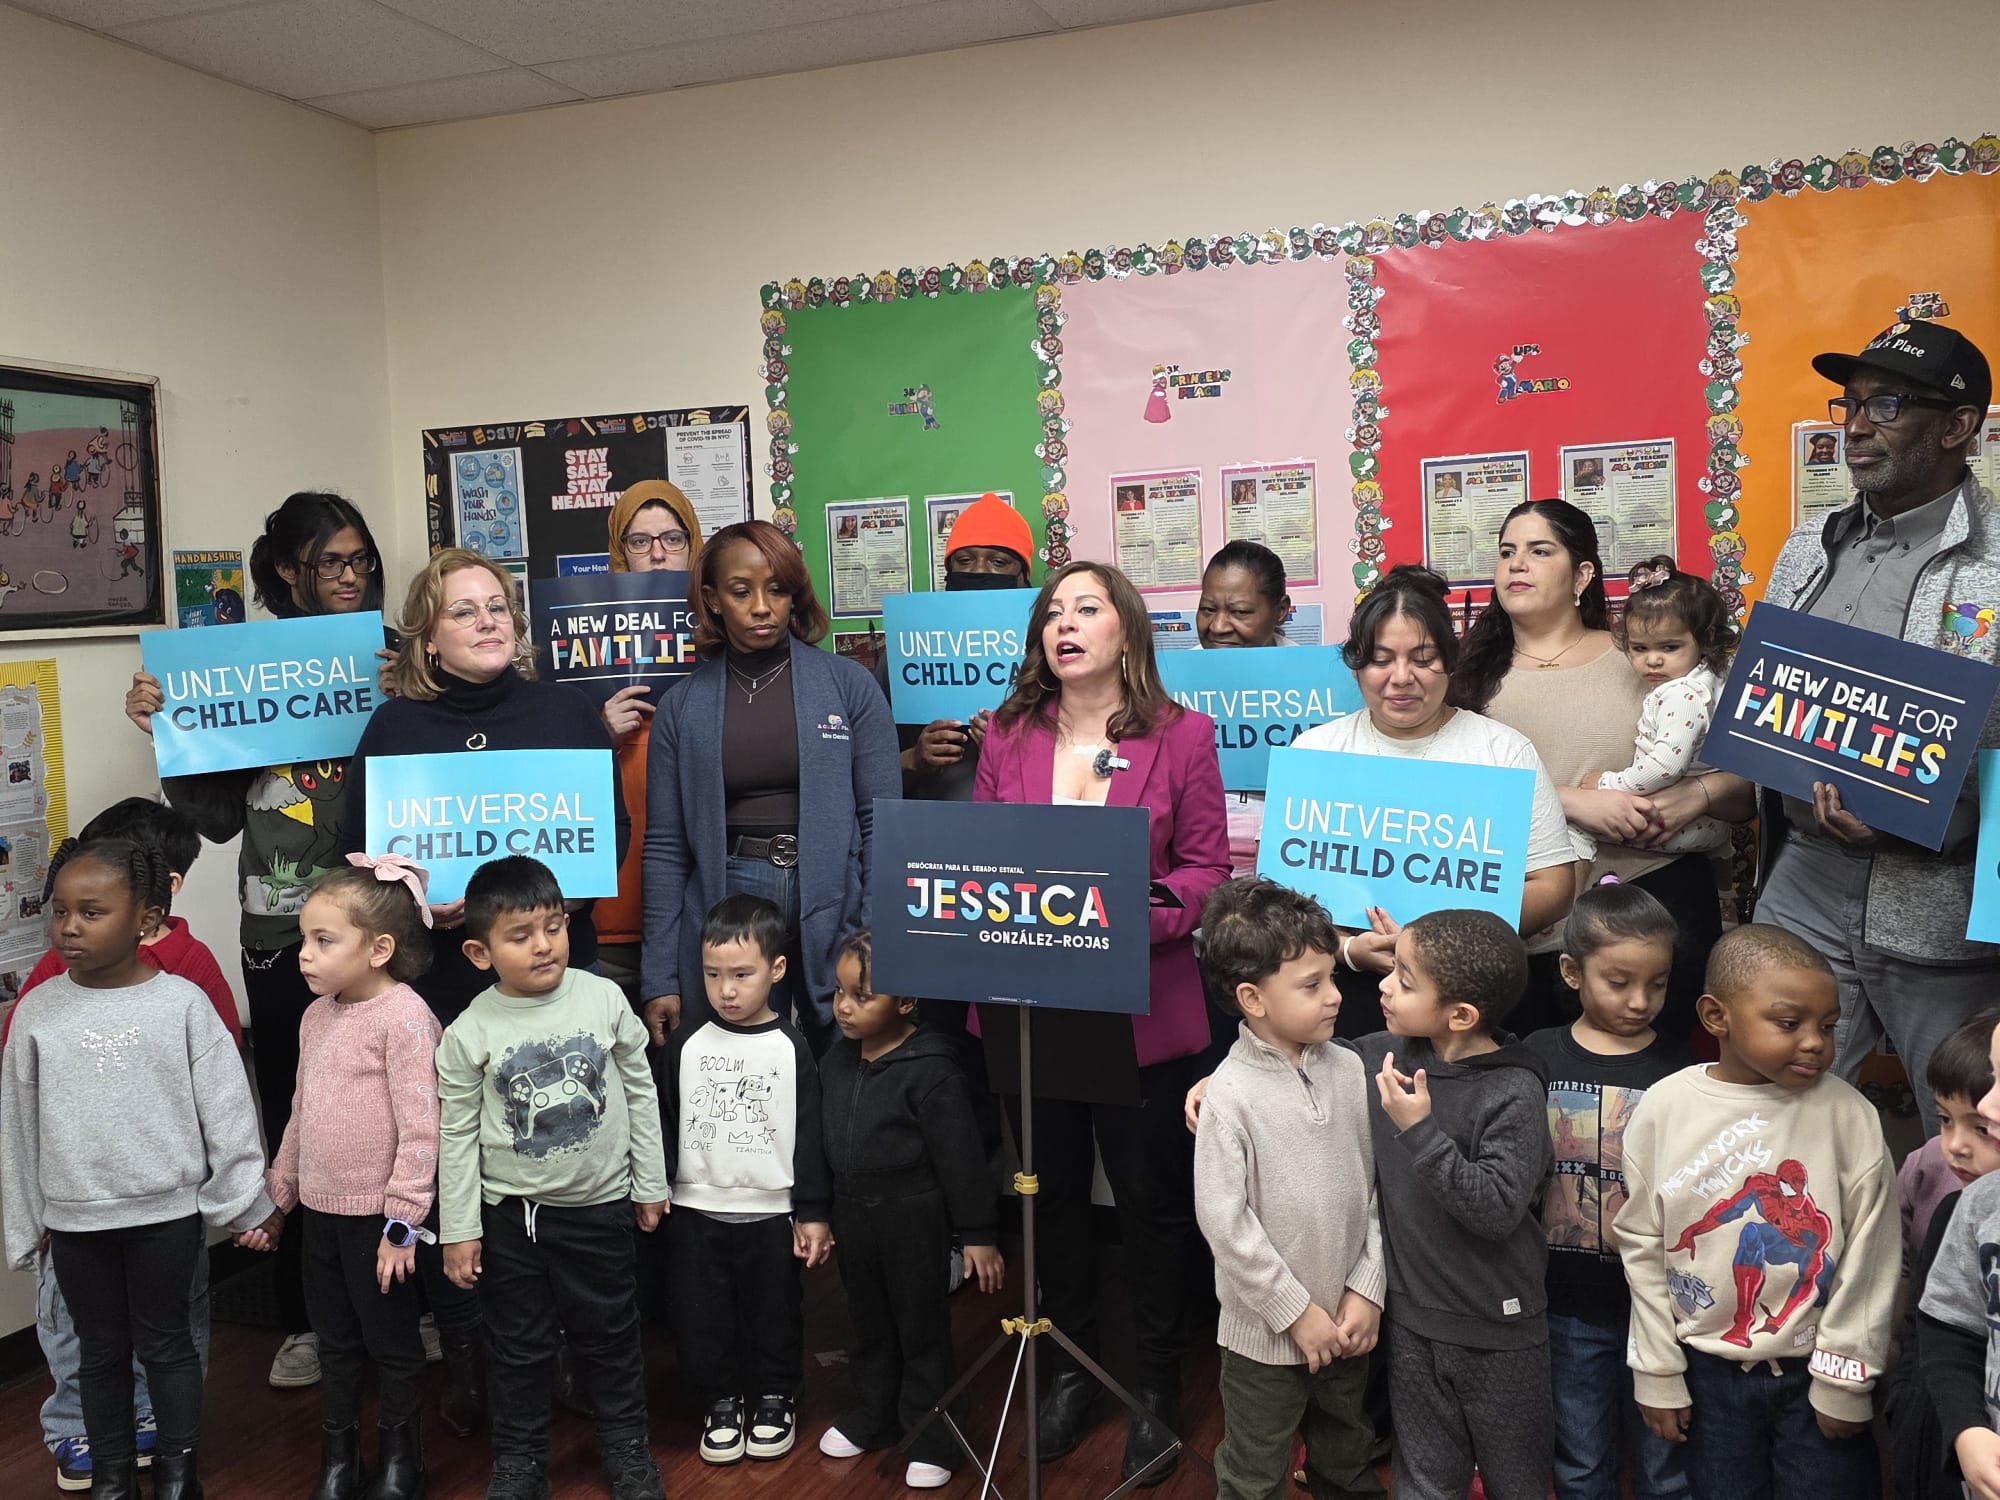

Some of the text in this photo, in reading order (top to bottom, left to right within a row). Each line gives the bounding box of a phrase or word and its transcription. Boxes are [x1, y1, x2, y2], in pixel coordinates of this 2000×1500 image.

[1513, 345, 1540, 356] UPK
[1892, 339, 1926, 358] Place
[1166, 364, 1179, 375] 3K
[903, 387, 916, 398] 3K
[1178, 384, 1221, 400] PEACH
[1518, 378, 1570, 393] MARIO
[565, 447, 609, 465] STAY
[566, 462, 613, 480] SAFE,
[567, 478, 608, 495] STAY
[463, 499, 485, 511] YOUR
[174, 551, 241, 564] HANDWASHING
[572, 563, 609, 573] Your Heal
[551, 611, 700, 636] A NEW DEAL FO
[551, 632, 696, 670] FAMILIE
[899, 630, 1026, 657] UNIVERS
[166, 655, 370, 701] UNIVERSAL
[902, 661, 1020, 686] CHILD CA
[171, 687, 373, 732] CHILD CARE
[1174, 687, 1347, 719] NIVERSAL
[1748, 657, 1958, 741] A NEW DEAL FOR
[1734, 682, 1946, 785] FAMILIES
[387, 792, 595, 829] UNIVERSAL
[1284, 796, 1504, 856] UNIVERSAL
[387, 827, 595, 860] CHILD CARE
[907, 861, 943, 870] DEMÓCRATA
[962, 864, 970, 872] EL
[999, 866, 1024, 874] ESTATAL
[1280, 838, 1502, 895] CHILD CARE
[907, 877, 1110, 928] JESSICA
[979, 928, 1110, 950] GONZÁLEZ-ROJAS
[1548, 1081, 1601, 1094] ITARIST
[683, 1140, 713, 1152] LOVE
[1662, 1111, 1770, 1197] NEW YORK
[1600, 1169, 1624, 1181] ROC
[1689, 1139, 1773, 1200] KNICKS
[1811, 1348, 1865, 1382] MARVEL
